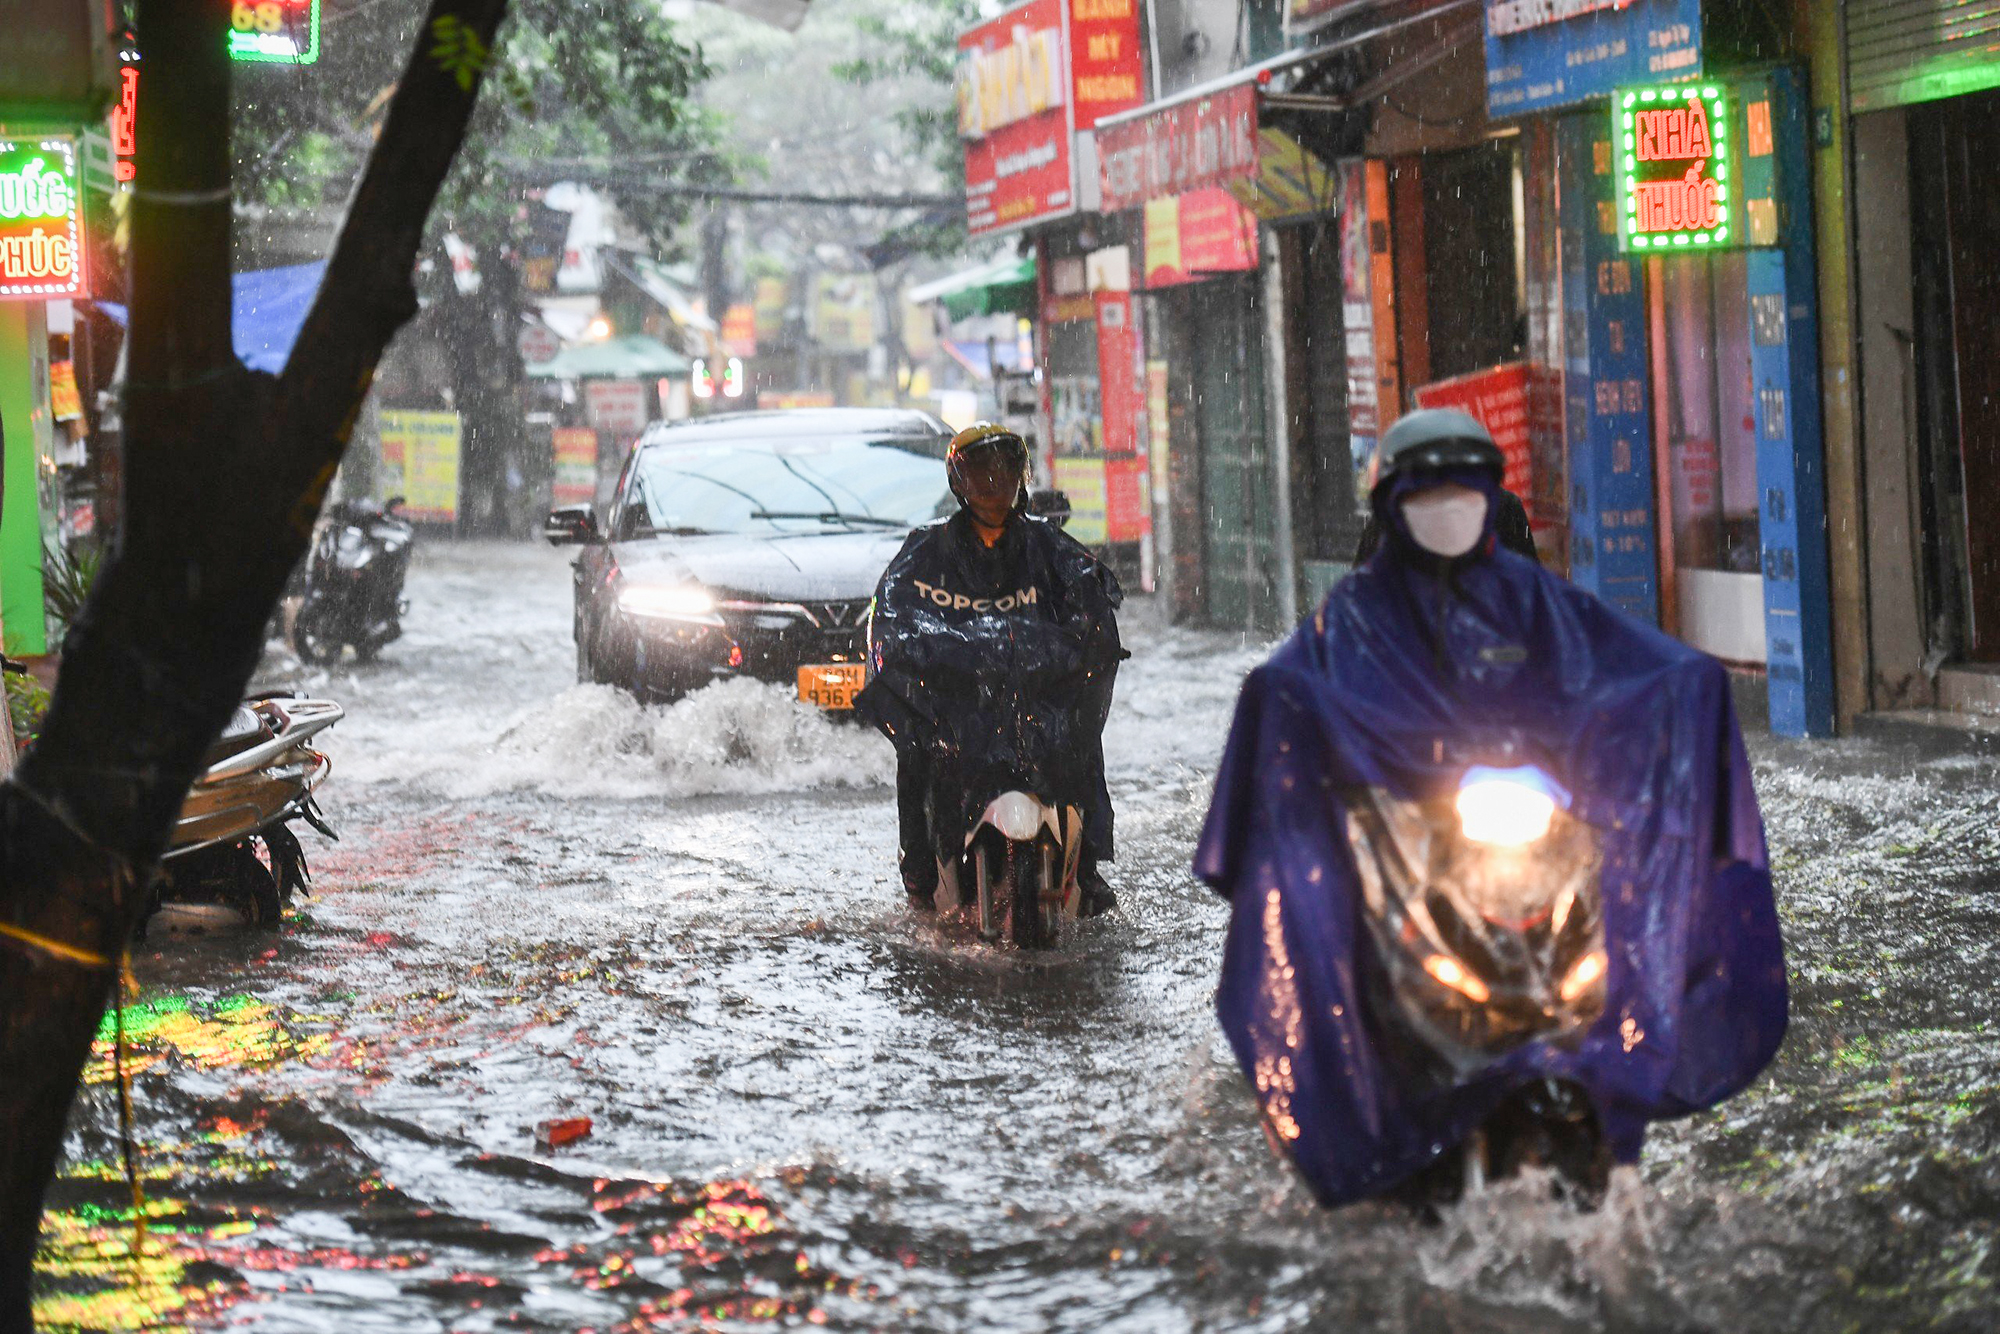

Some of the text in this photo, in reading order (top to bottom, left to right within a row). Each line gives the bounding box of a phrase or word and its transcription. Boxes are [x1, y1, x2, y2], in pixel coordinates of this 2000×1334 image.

[1635, 98, 1712, 161] NHÀ
[1634, 160, 1720, 232] THUỐC
[0, 228, 71, 278] HÚC
[913, 579, 1037, 612] TOPCOM
